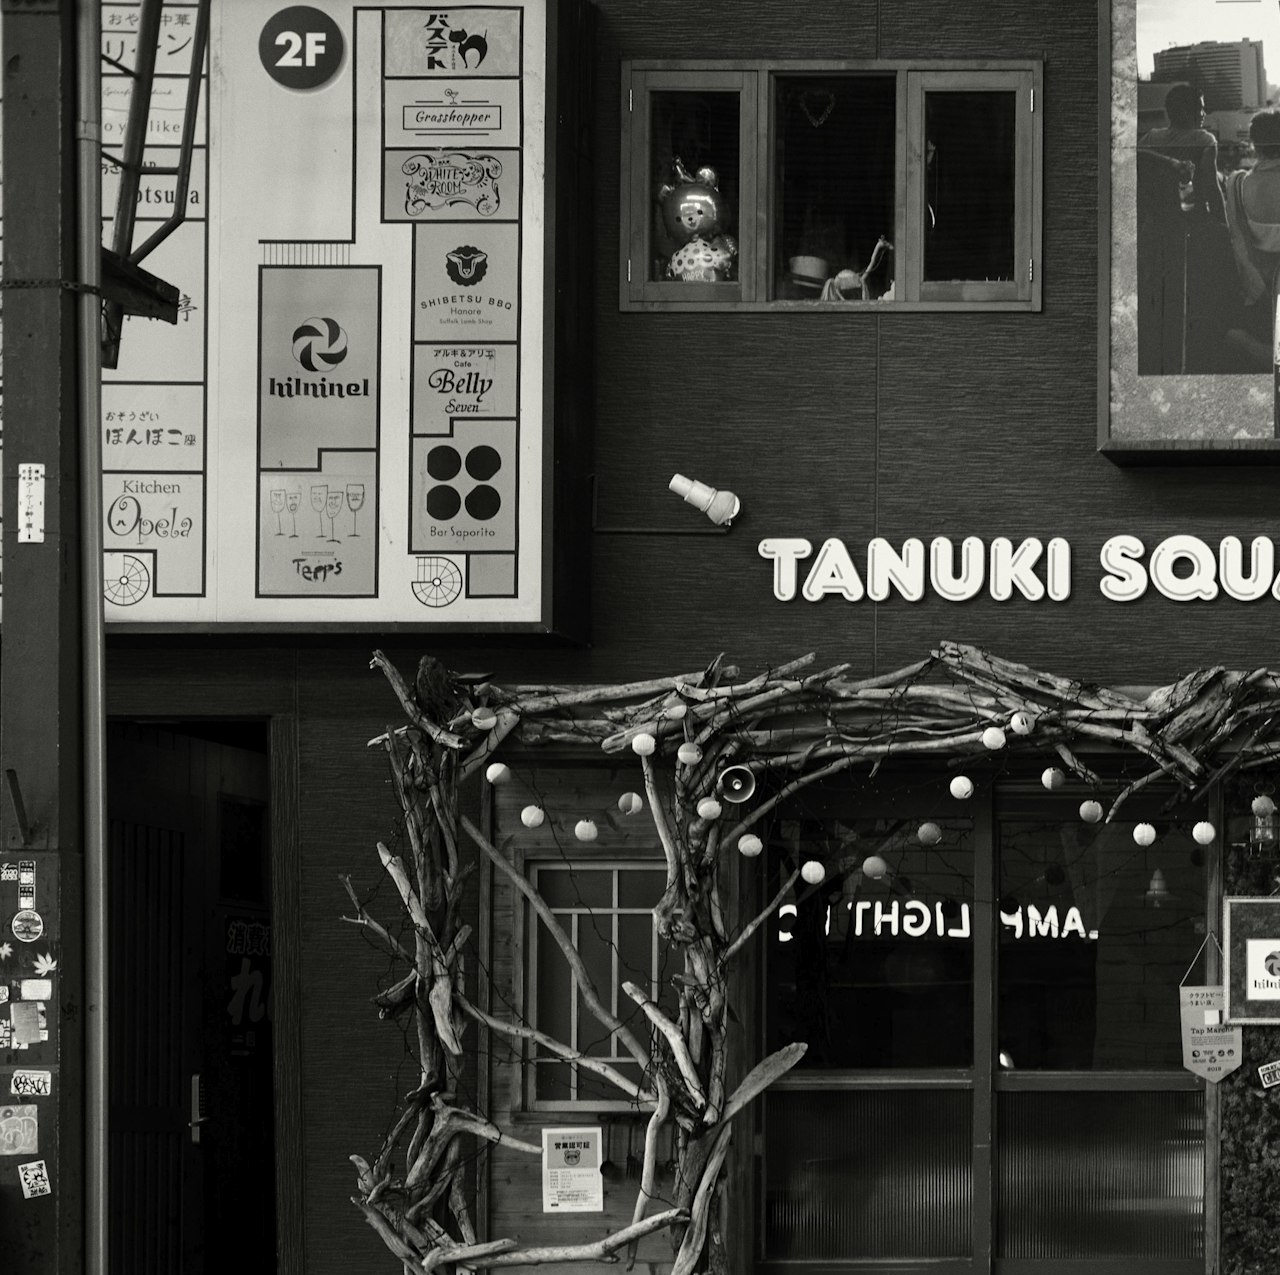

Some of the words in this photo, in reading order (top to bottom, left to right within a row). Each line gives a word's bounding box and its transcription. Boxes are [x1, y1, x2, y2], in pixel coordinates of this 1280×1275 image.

[274, 31, 328, 68] 2F
[424, 14, 450, 70] バステト
[415, 109, 491, 127] Grasshopper
[420, 295, 482, 310] SHIBETSU
[488, 297, 512, 311] BBQ
[450, 307, 482, 316] Hanare
[454, 360, 472, 369] Cafe
[428, 368, 493, 403] Belly
[444, 398, 479, 414] Seven
[106, 411, 159, 422] おそうざい
[123, 480, 181, 495] Kitchen
[107, 495, 193, 545] Opela
[430, 525, 447, 537] Bar
[450, 525, 495, 541] Saporito
[758, 537, 1071, 603] TANUKI
[1190, 1027, 1205, 1037] Tap
